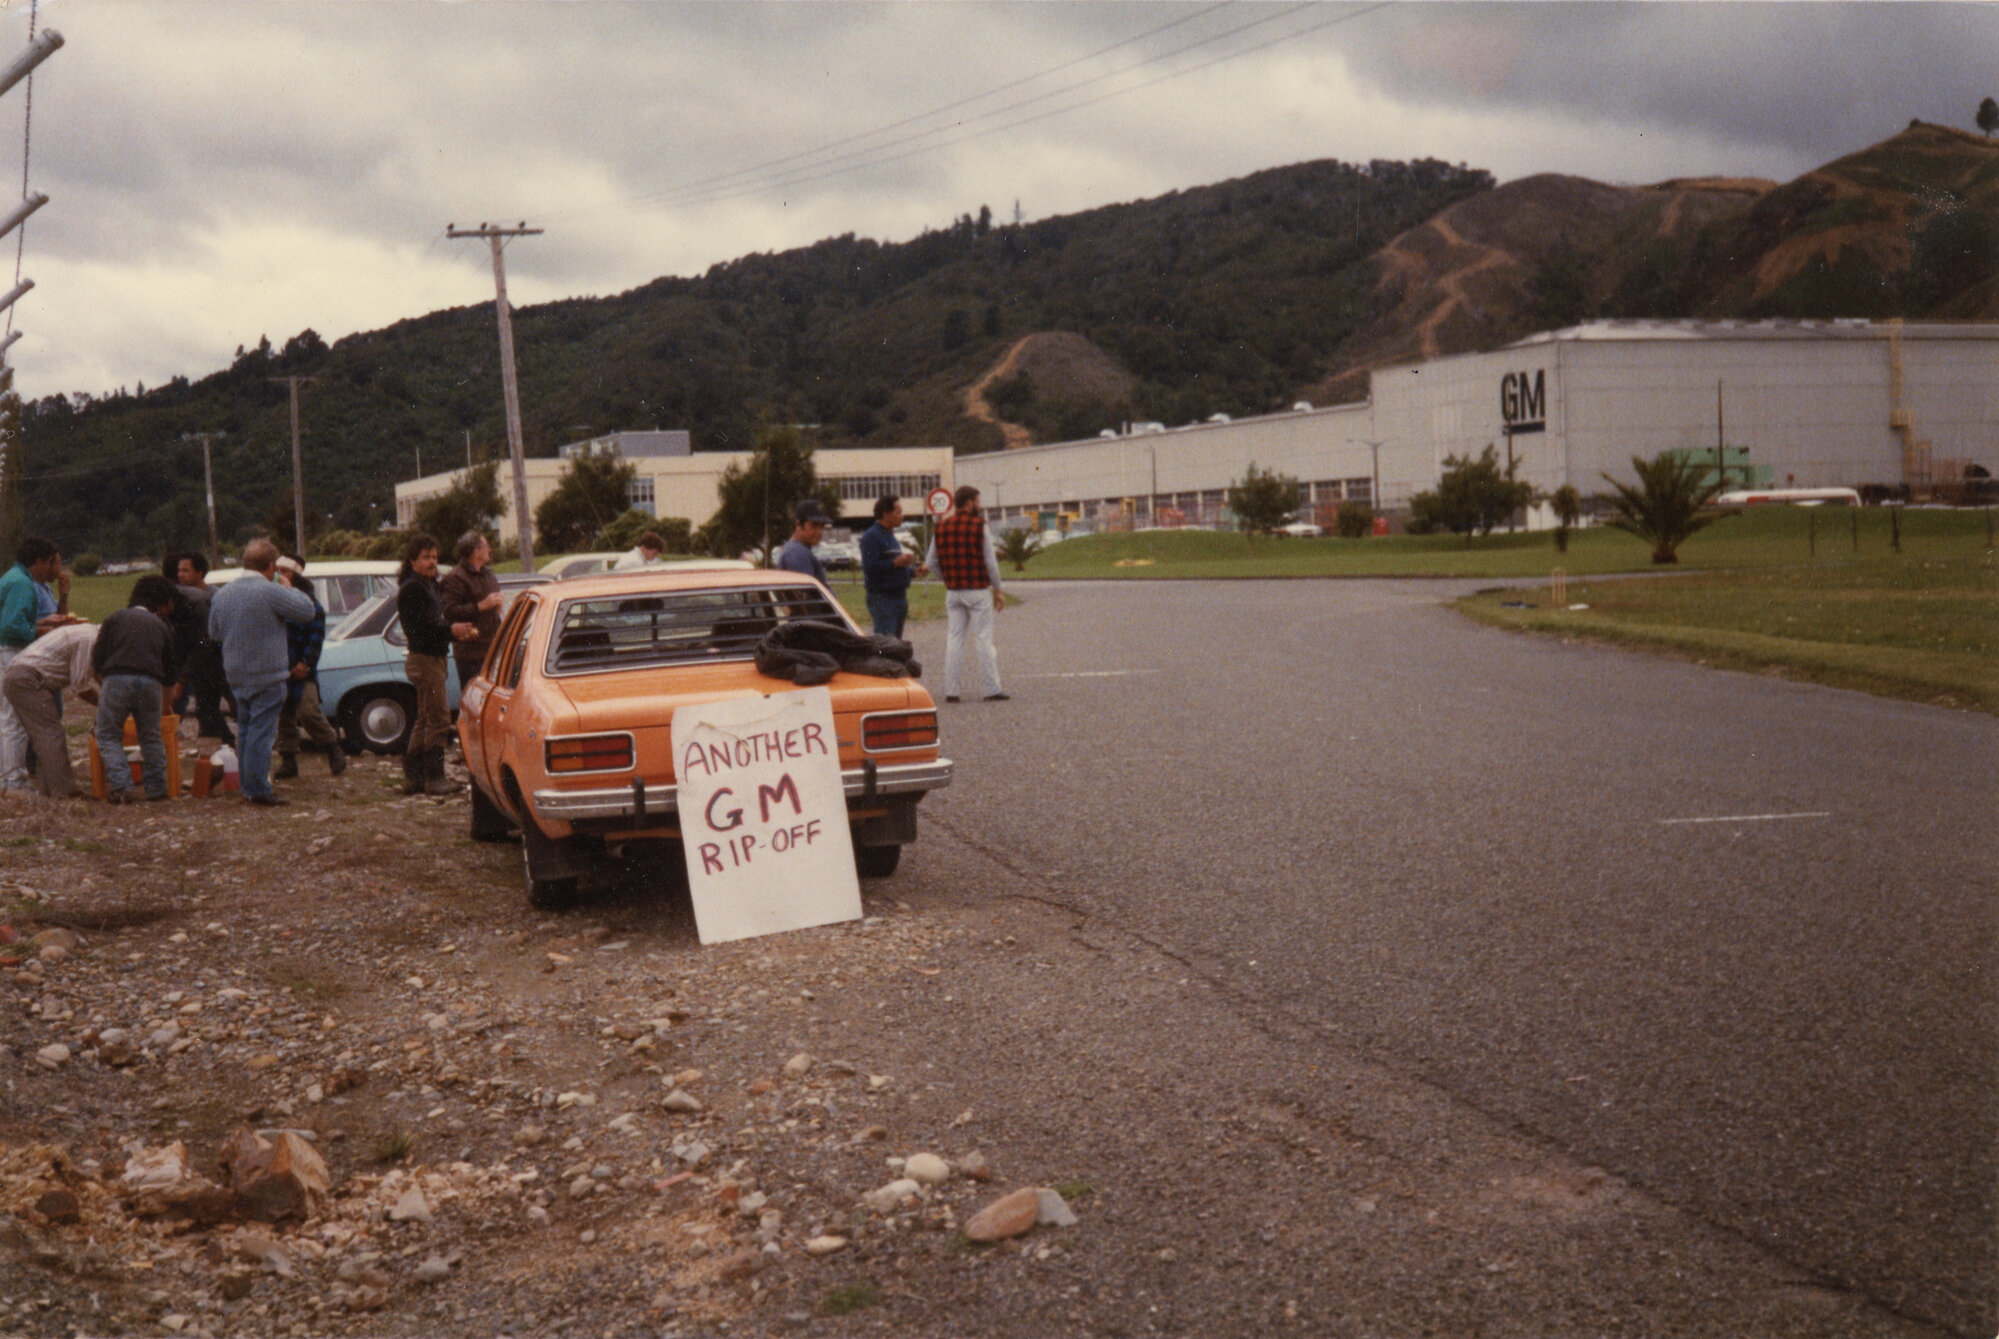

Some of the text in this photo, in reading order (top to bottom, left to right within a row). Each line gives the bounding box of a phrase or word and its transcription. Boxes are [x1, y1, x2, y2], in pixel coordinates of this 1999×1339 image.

[1501, 369, 1545, 420] GM
[684, 723, 828, 783] ANOTHER
[705, 773, 802, 832] GM
[698, 819, 821, 875] RIP-OFF
